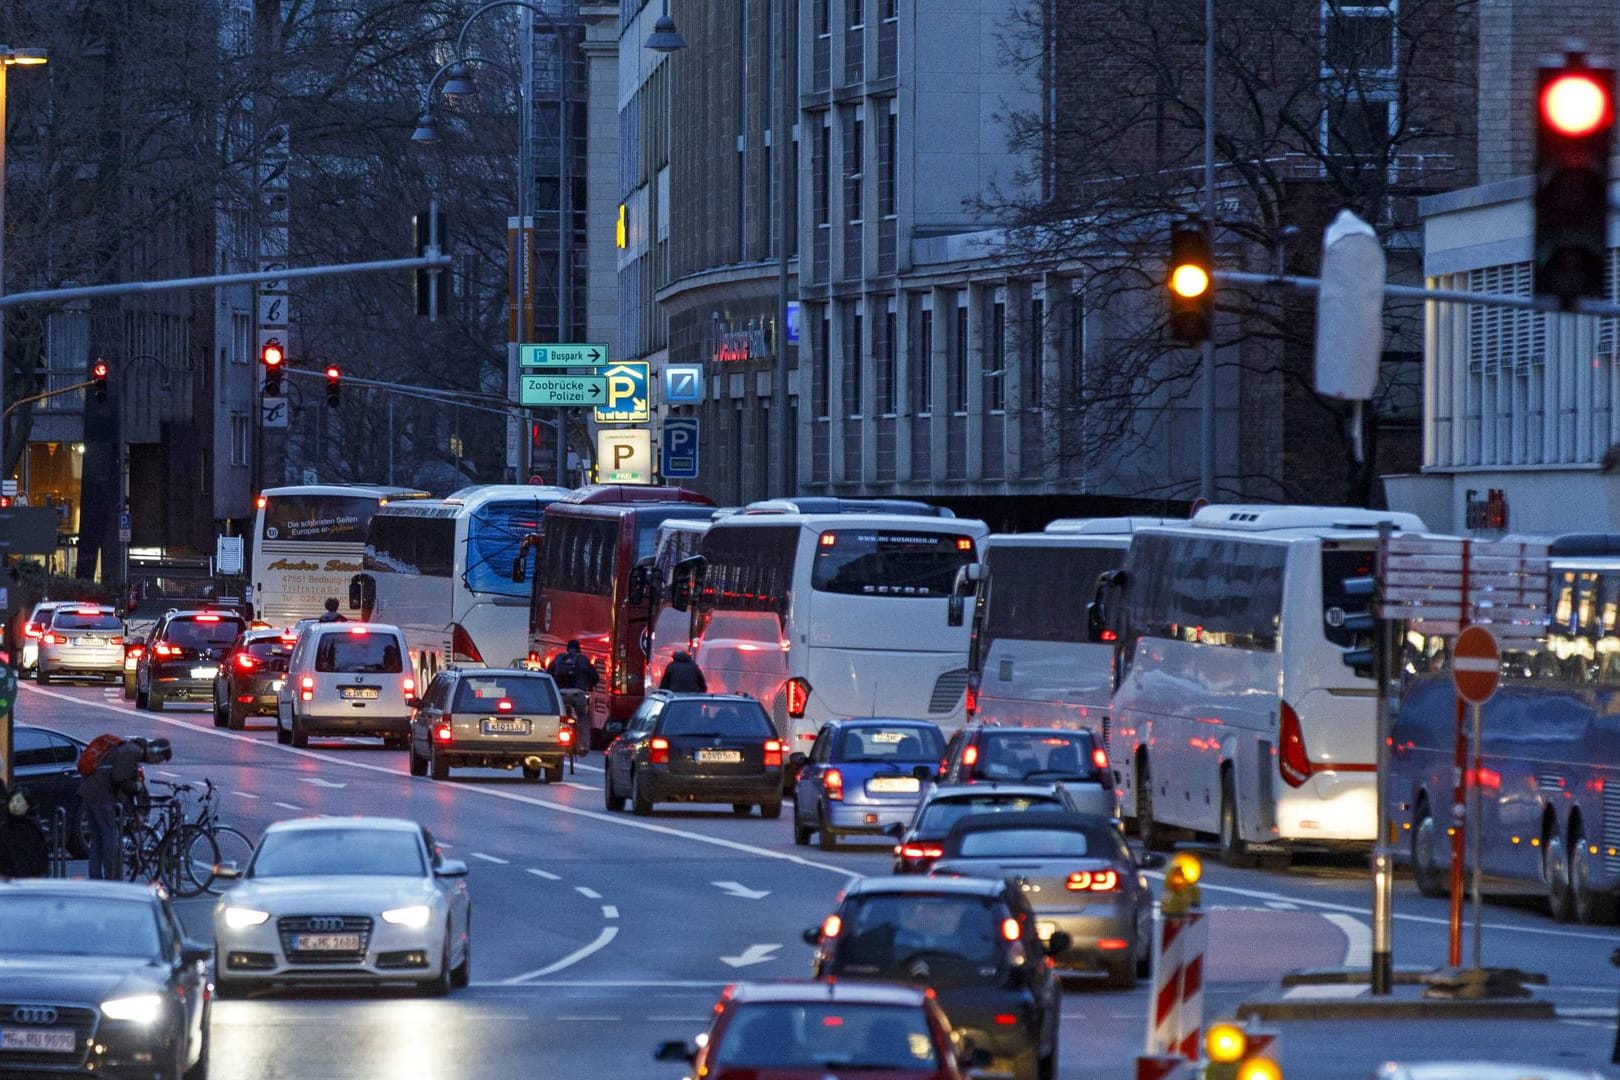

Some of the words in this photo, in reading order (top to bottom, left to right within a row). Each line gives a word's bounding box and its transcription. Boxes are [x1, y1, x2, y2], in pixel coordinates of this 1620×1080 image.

[550, 351, 584, 362] Buspark
[528, 379, 585, 391] Zoobrücke
[608, 376, 636, 408] P
[549, 391, 585, 401] Polizei
[671, 430, 689, 452] P
[613, 444, 635, 470] P
